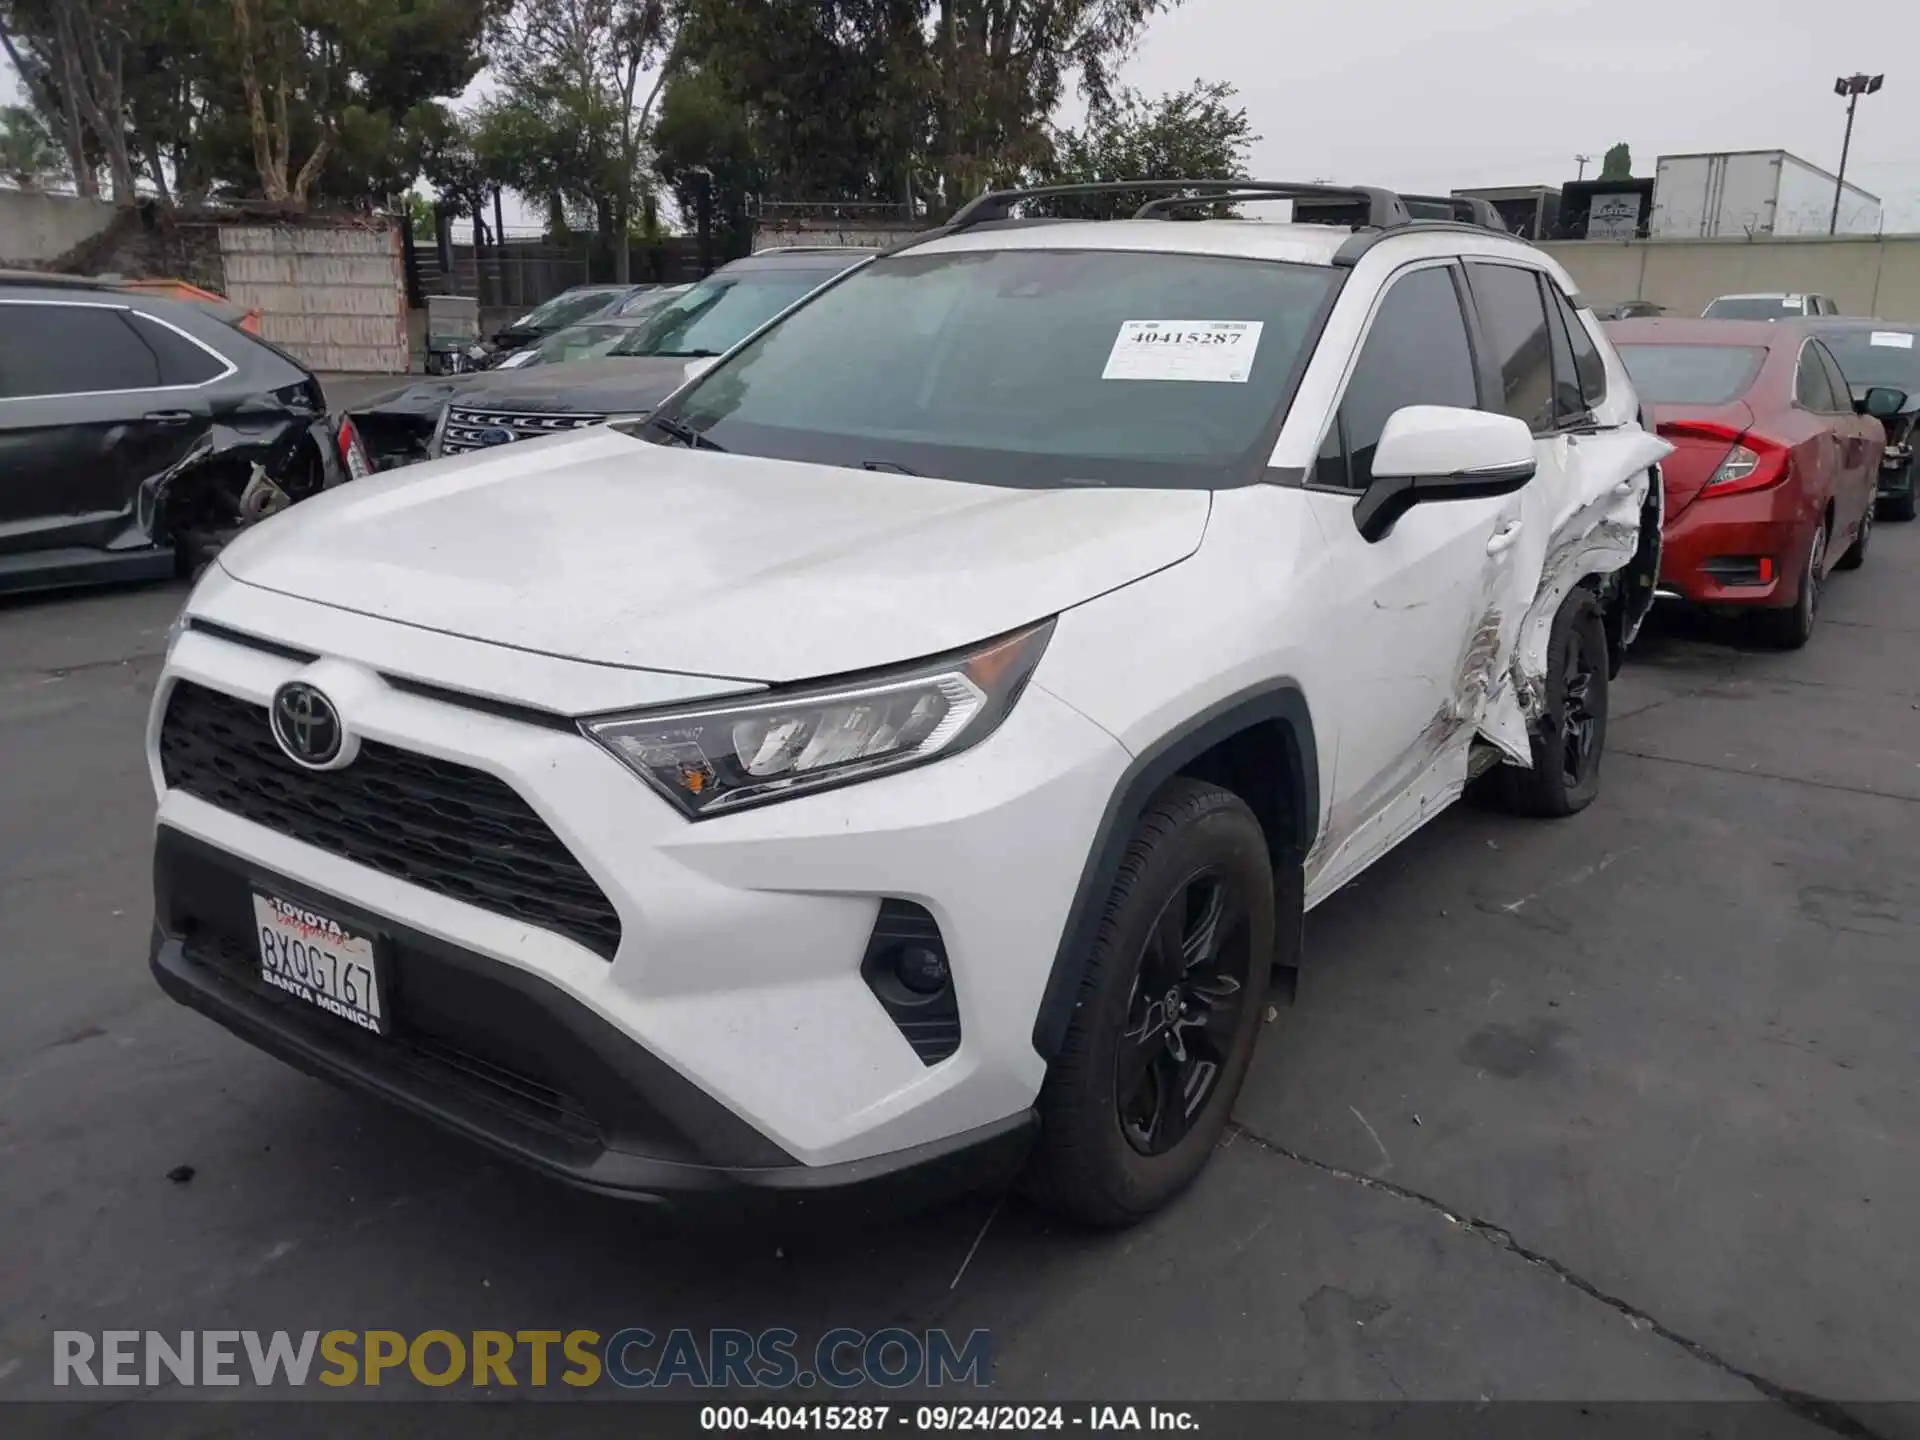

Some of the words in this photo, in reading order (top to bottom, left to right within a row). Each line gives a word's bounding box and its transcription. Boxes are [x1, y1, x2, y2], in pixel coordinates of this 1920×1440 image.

[1131, 332, 1242, 345] 40415287
[272, 896, 341, 934] TOYOTA
[262, 969, 313, 1003] SANTA
[316, 992, 381, 1034] MONICA
